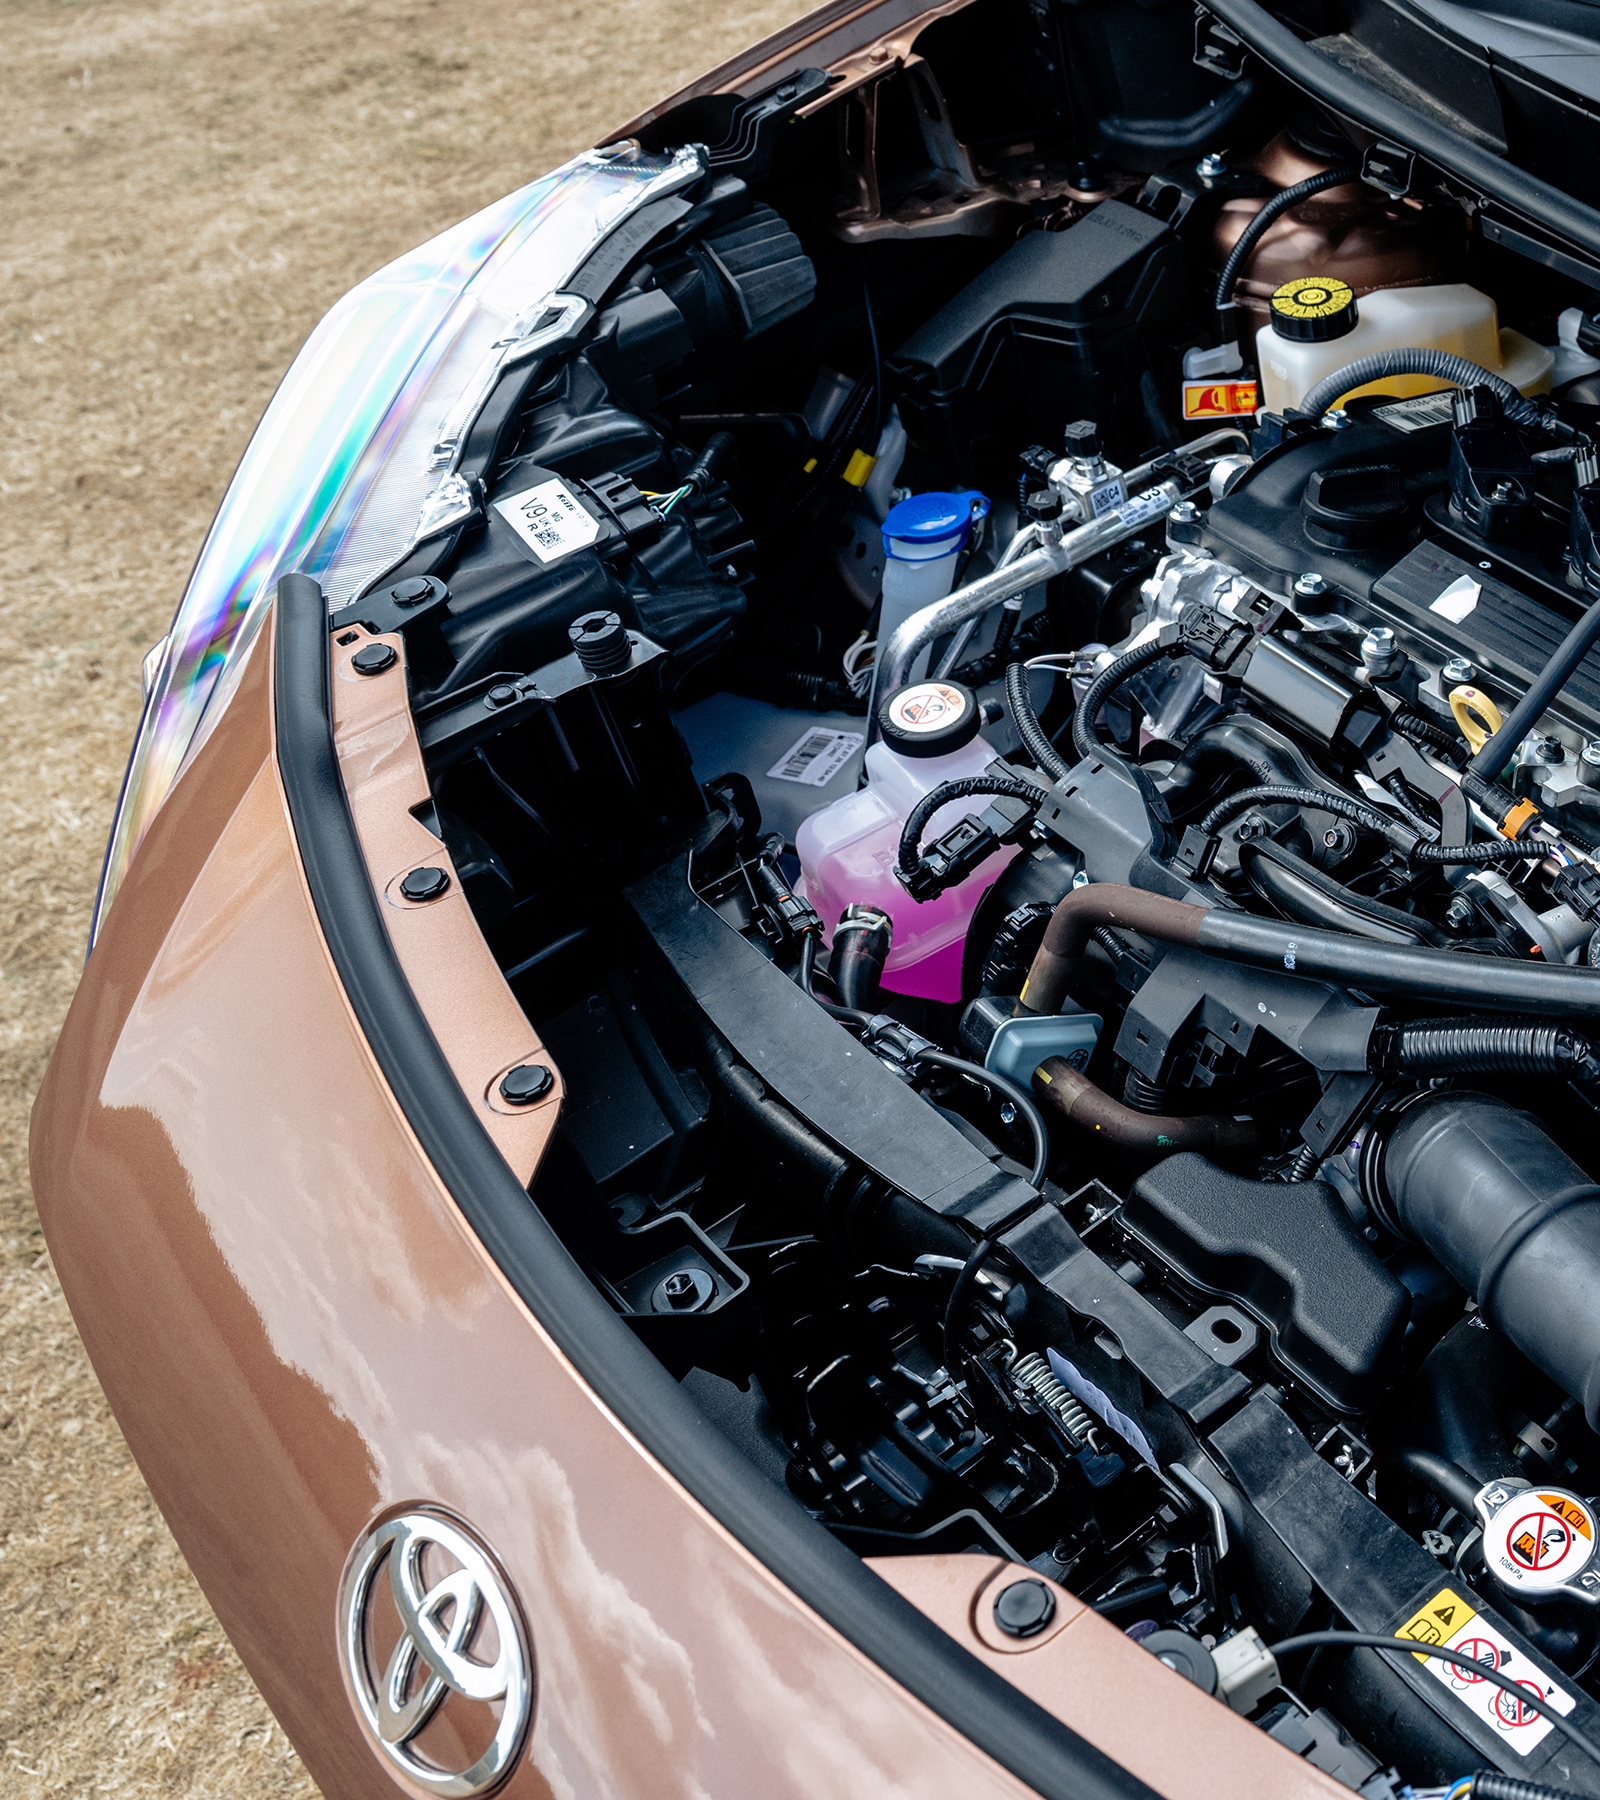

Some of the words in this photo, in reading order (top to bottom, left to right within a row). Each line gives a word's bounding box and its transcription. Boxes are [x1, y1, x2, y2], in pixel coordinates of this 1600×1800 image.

[520, 495, 547, 522] V9
[538, 515, 551, 528] UK
[550, 510, 563, 523] MG
[527, 521, 538, 532] R
[1499, 1556, 1523, 1580] 108kPa
